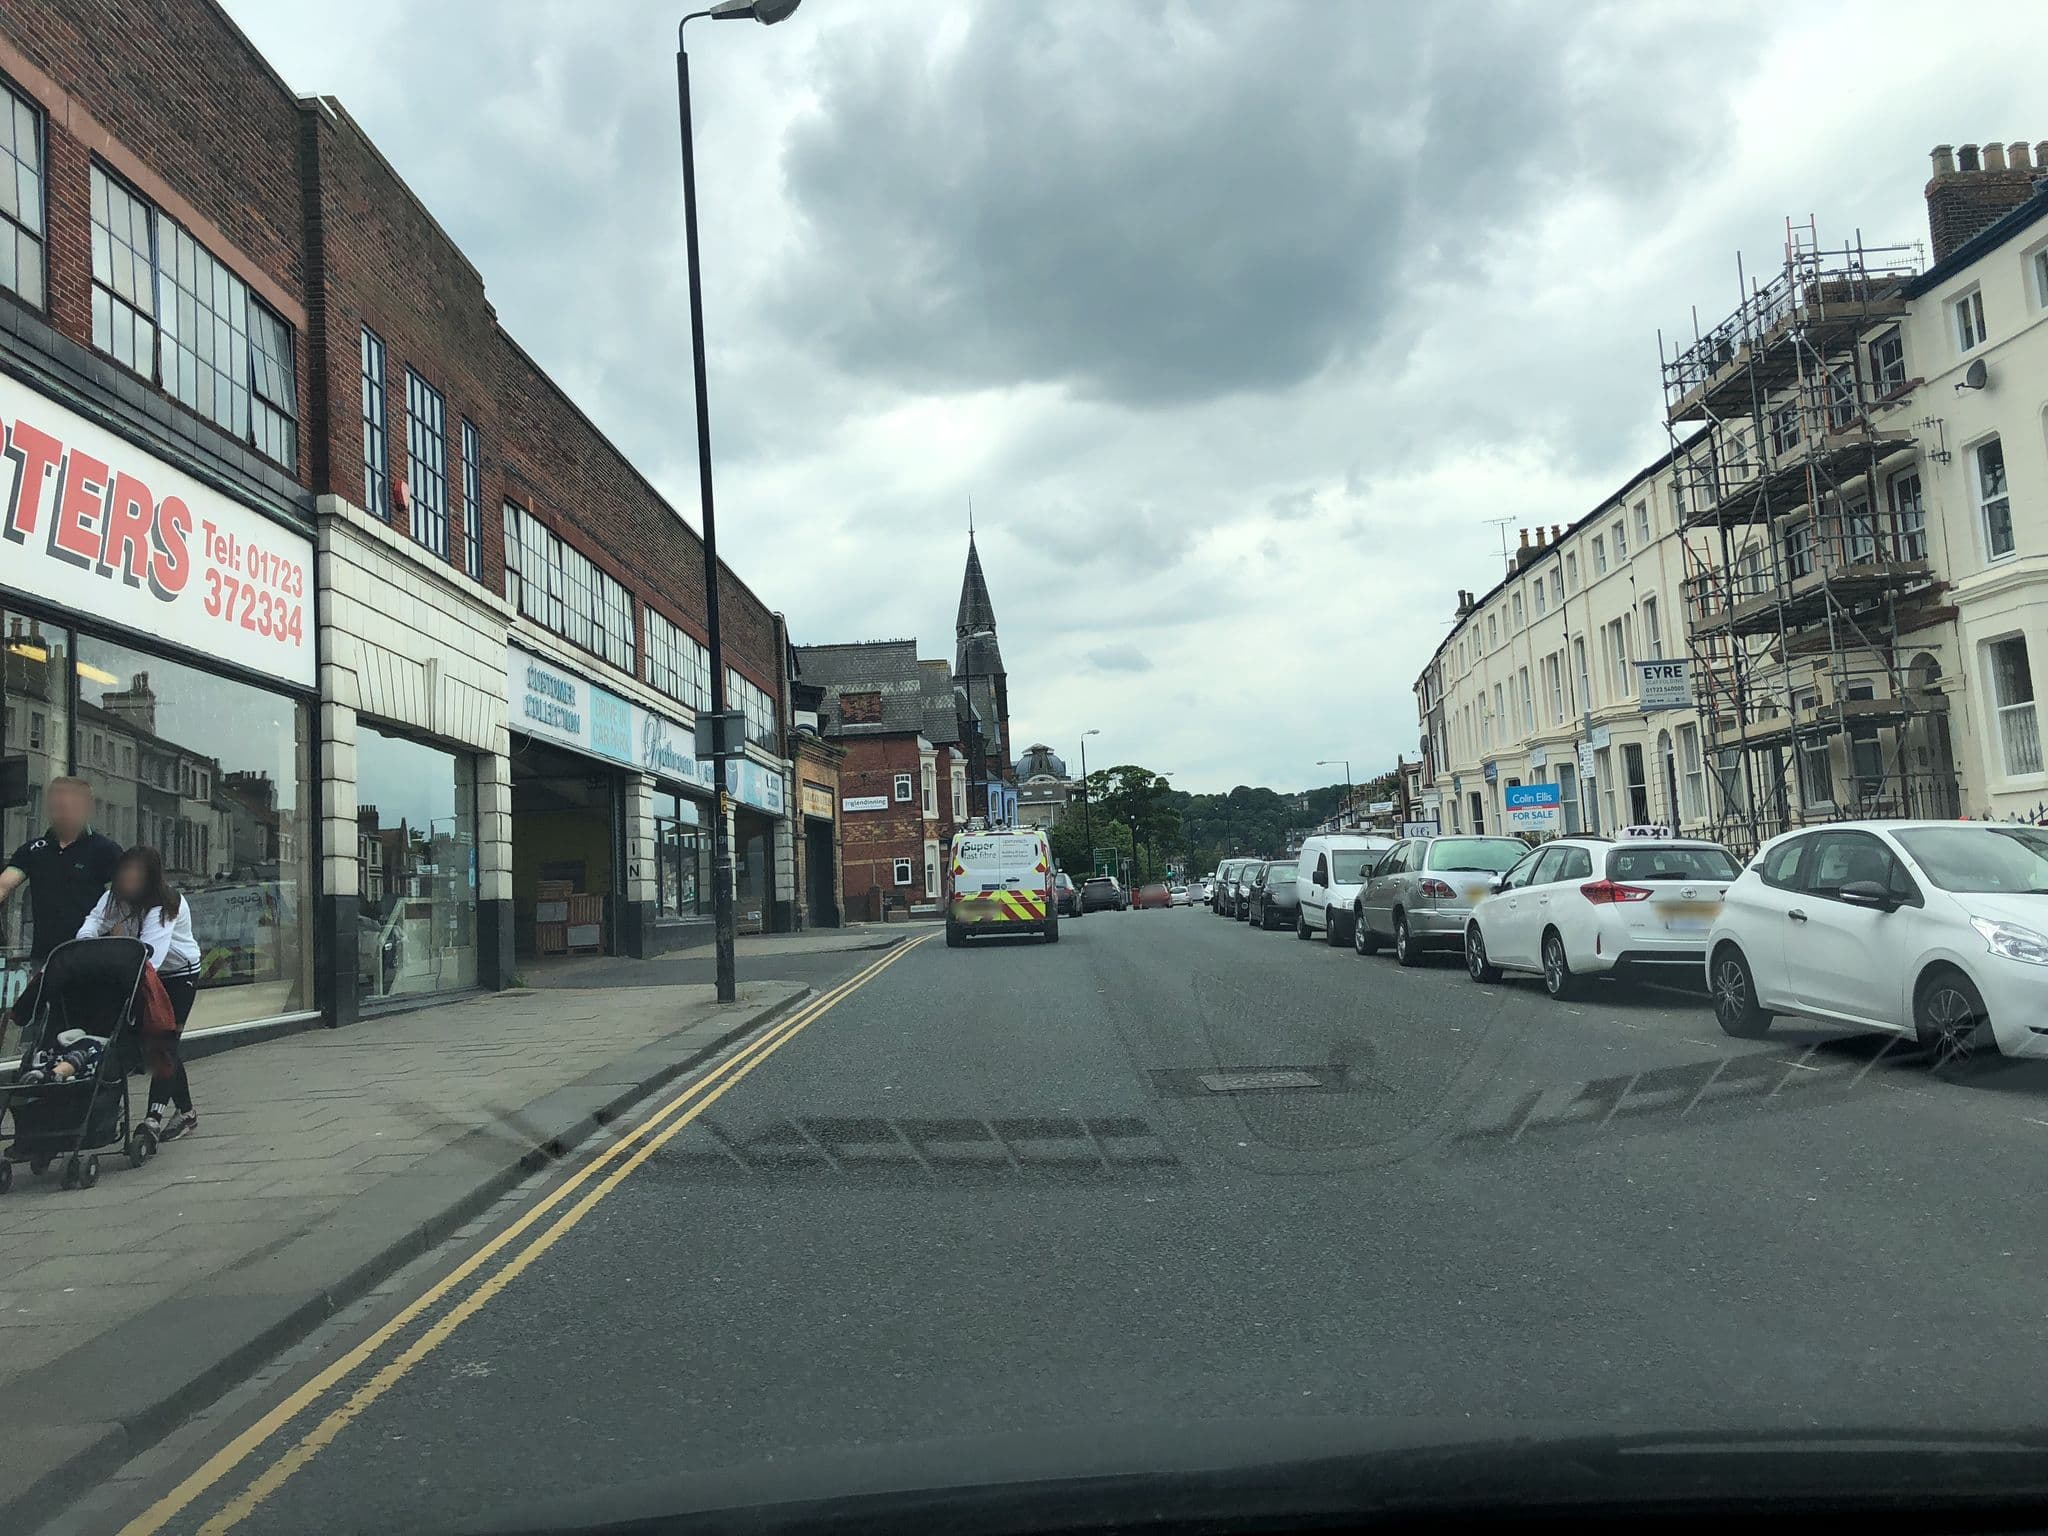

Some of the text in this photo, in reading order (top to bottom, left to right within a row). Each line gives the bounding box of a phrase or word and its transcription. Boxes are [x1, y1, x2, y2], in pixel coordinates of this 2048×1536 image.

[0, 413, 193, 600] TERS
[202, 519, 303, 598] Tel: 01723
[204, 567, 302, 647] 372334
[527, 665, 576, 706] CUSTOMER
[1644, 665, 1683, 679] EYRE
[525, 693, 581, 735] COLLECTION
[1512, 792, 1552, 803] Colin Ellis
[1513, 810, 1553, 821] FOR SALE
[1628, 828, 1668, 836] TAXI
[964, 841, 994, 852] Super
